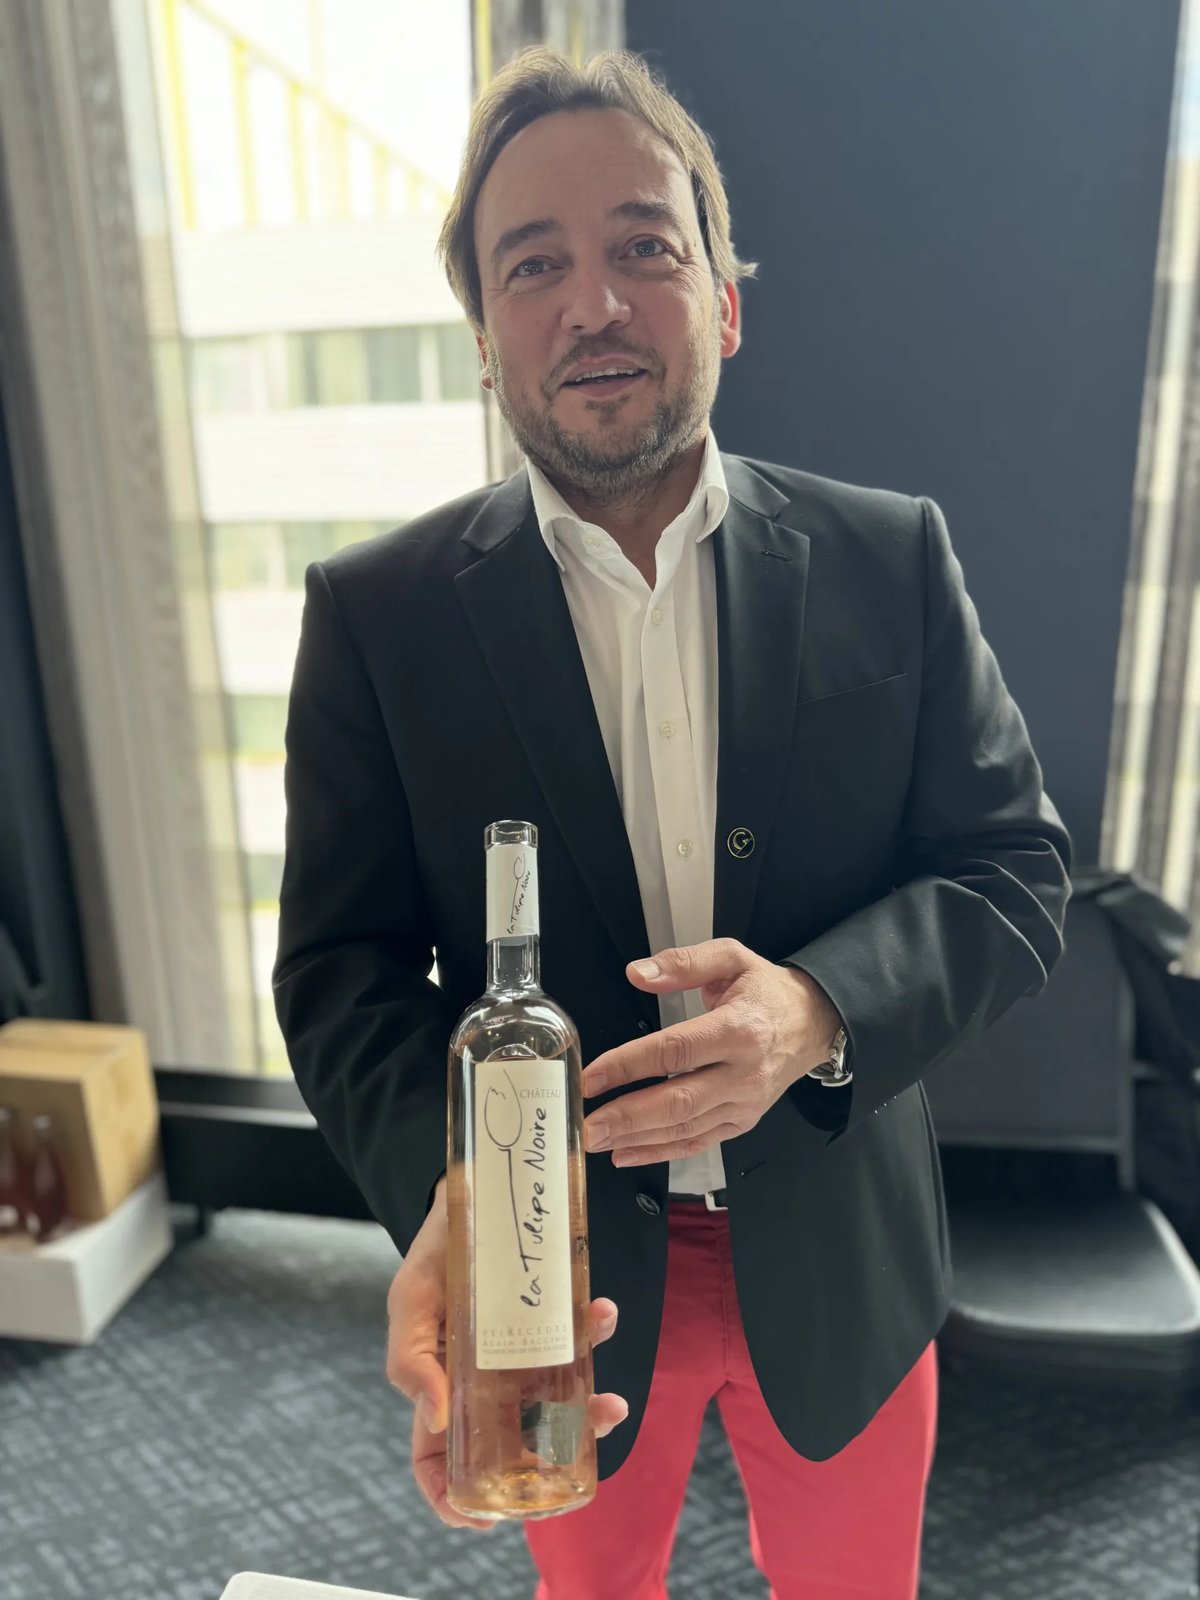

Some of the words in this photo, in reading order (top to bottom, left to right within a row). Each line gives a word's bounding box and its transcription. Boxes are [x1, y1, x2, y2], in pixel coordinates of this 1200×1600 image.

[519, 1087, 561, 1099] CHÂTEAU
[522, 1107, 548, 1172] Noire
[523, 1183, 552, 1274] Tulipe
[519, 1276, 541, 1308] la
